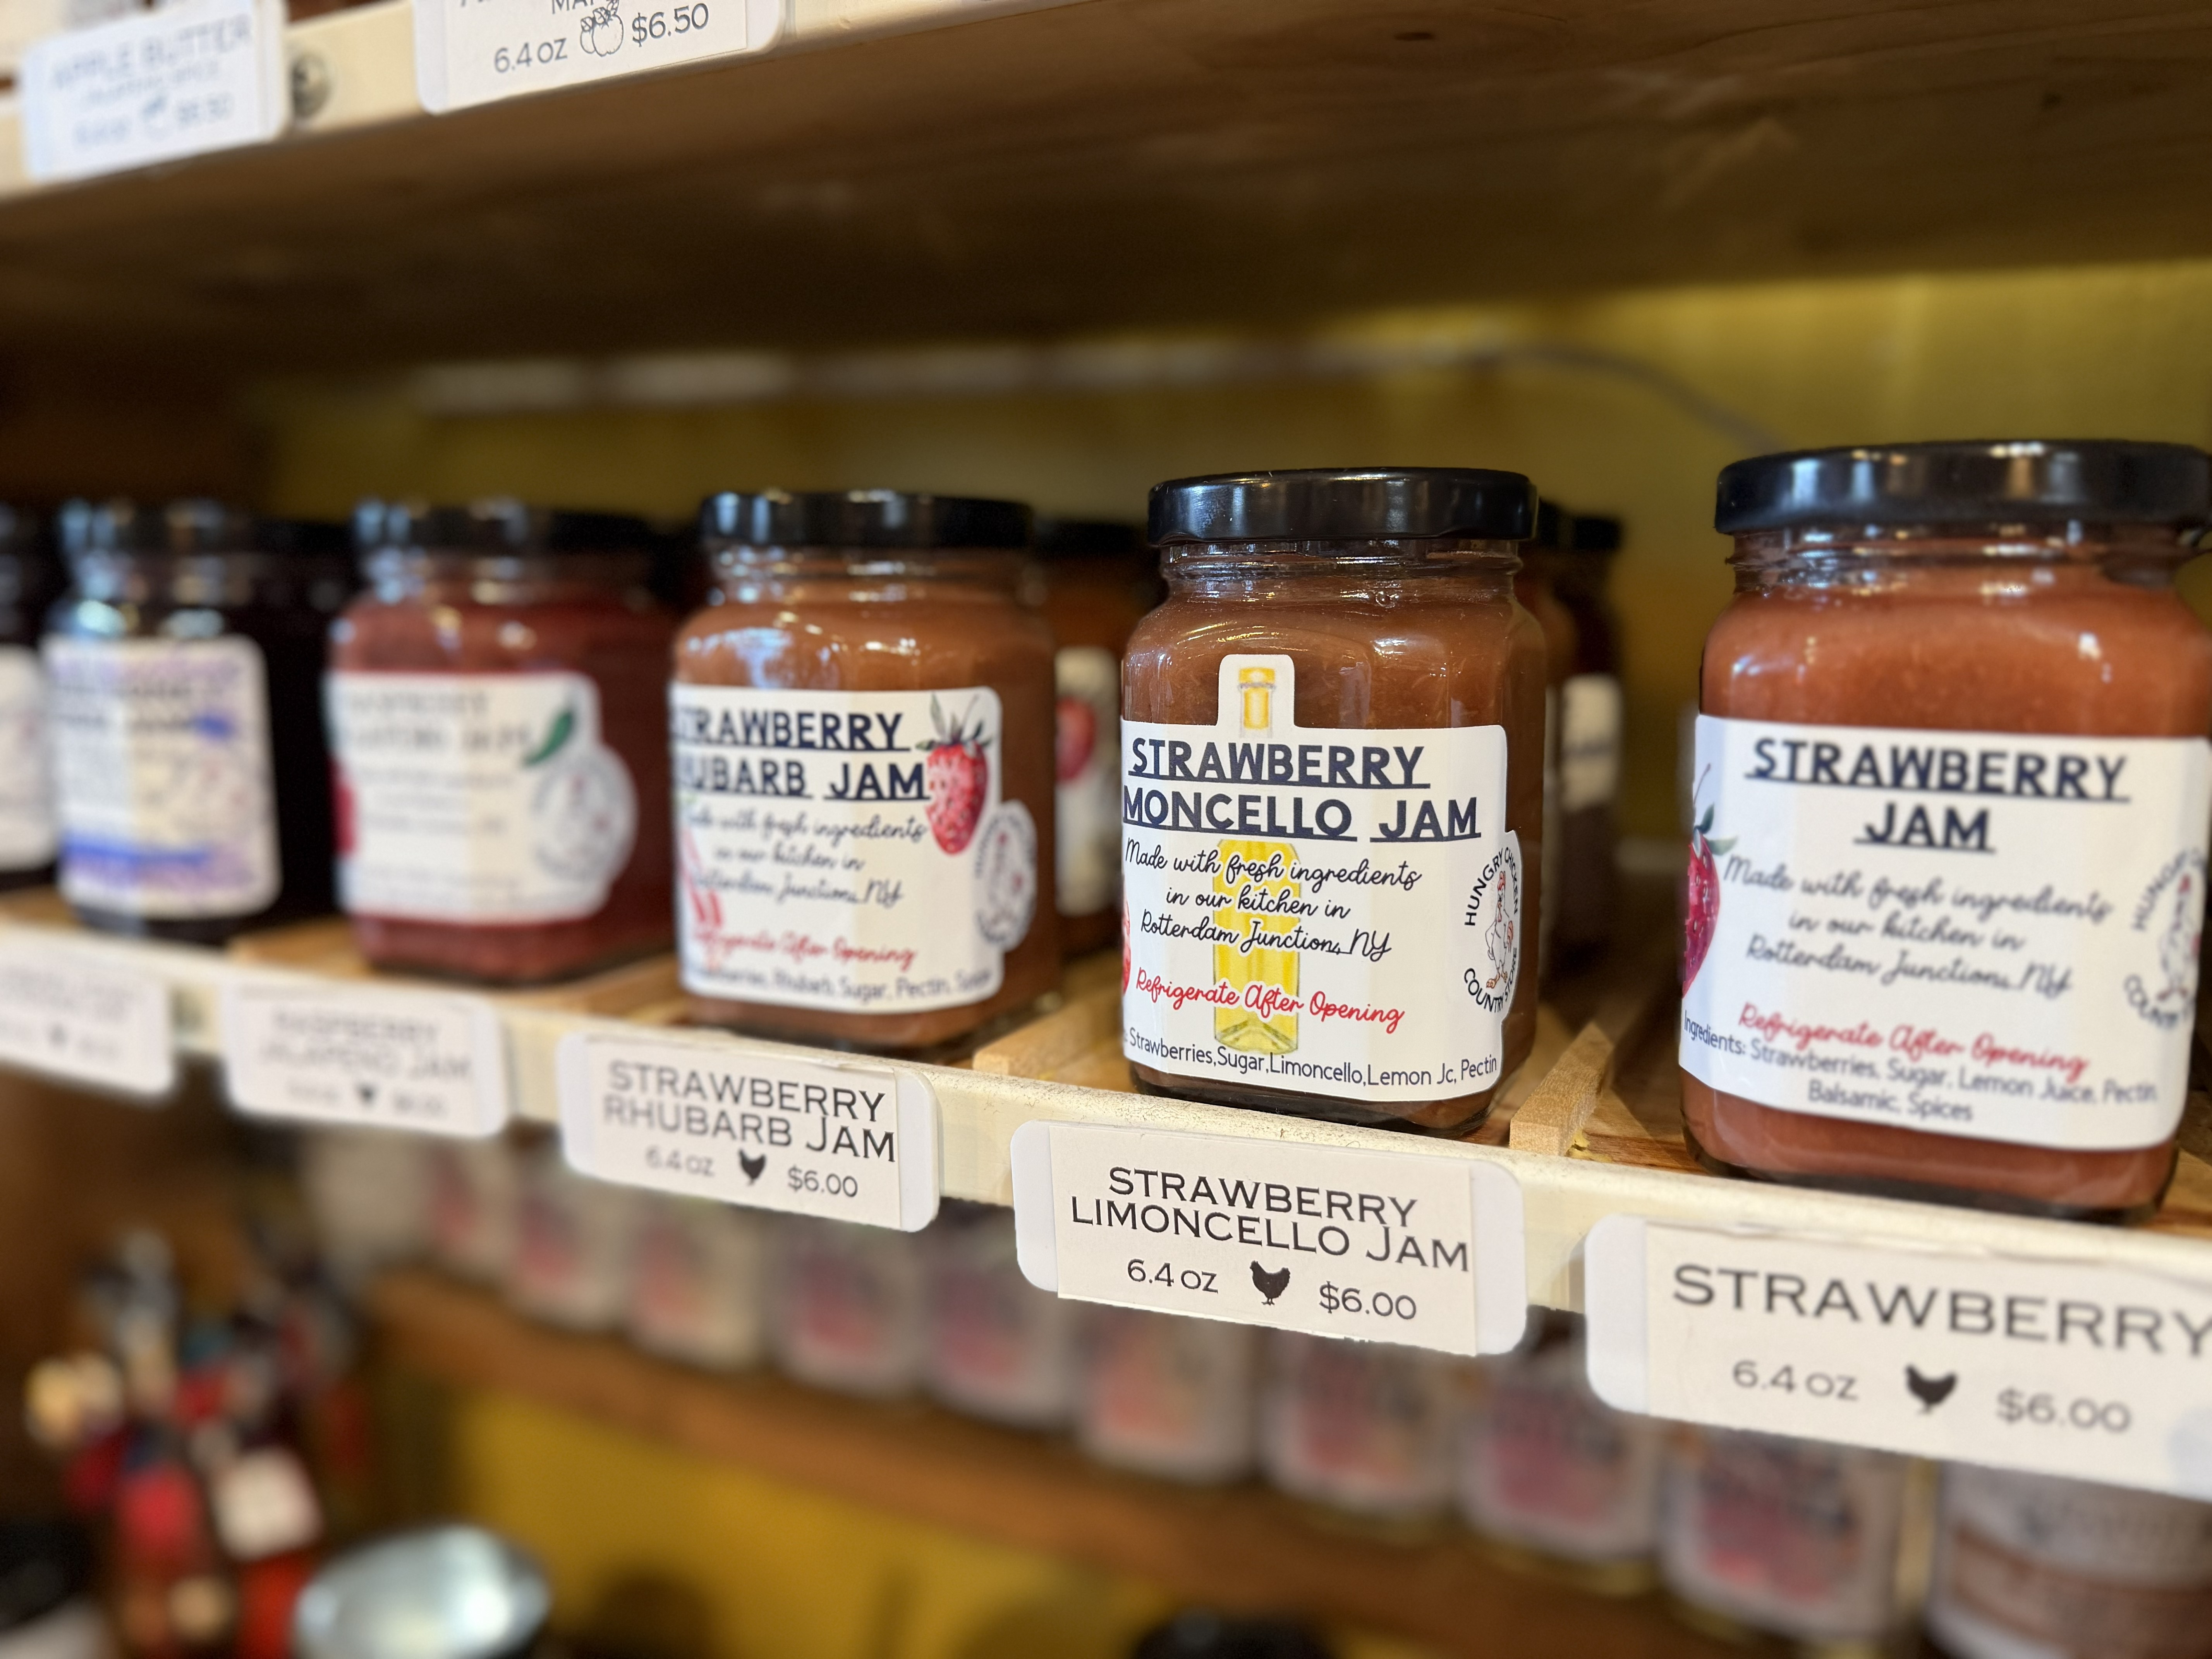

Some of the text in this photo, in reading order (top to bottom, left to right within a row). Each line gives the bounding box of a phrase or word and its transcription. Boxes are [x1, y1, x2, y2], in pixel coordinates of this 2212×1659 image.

[494, 43, 532, 73] 6.4
[632, 4, 709, 47] $6.50
[822, 762, 931, 800] JAM
[1128, 737, 1431, 790] STRAWBERRY
[1745, 737, 2131, 803] STRAWBERRY
[812, 813, 929, 850] ingredients
[1123, 785, 1482, 843] MONCELLO JAM
[1853, 801, 1996, 855] JAM
[1125, 837, 1422, 893] Made with fresh ingredients
[1464, 848, 1503, 926] HUNGRY
[1723, 854, 2115, 926] Made with fresh ingredients
[1166, 884, 1351, 919] in our kitchen in
[1788, 908, 2027, 951] in our kitchen in
[1141, 909, 1240, 944] Rotterdam
[1349, 928, 1392, 962] NY
[1746, 933, 1882, 976] Rotterdam
[1136, 967, 1405, 1034] Refrigerate After Opening
[1464, 968, 1504, 1013] COUNTRY
[1436, 1063, 1457, 1084] Jc,
[1460, 1054, 1497, 1081] Pectin
[1684, 1010, 1746, 1055] Ingredients:
[1958, 1064, 2034, 1097] Lemon
[1738, 1003, 2090, 1085] Refrigerate After Opening
[608, 1059, 886, 1123] STRAWBERRY
[1907, 1090, 1974, 1122] Spices
[602, 1093, 897, 1163] RHUBARB JAM
[787, 1165, 859, 1198] $6.00
[1108, 1166, 1418, 1227] STRAWBERRY
[1071, 1195, 1470, 1272] LIMONCELLO JAM
[1127, 1258, 1175, 1287] 6.4
[1318, 1281, 1417, 1320] $6.00
[1672, 1262, 2212, 1358] STRAWBERRY
[1732, 1359, 1797, 1394] 6.4
[1994, 1386, 2133, 1436] $6.00
